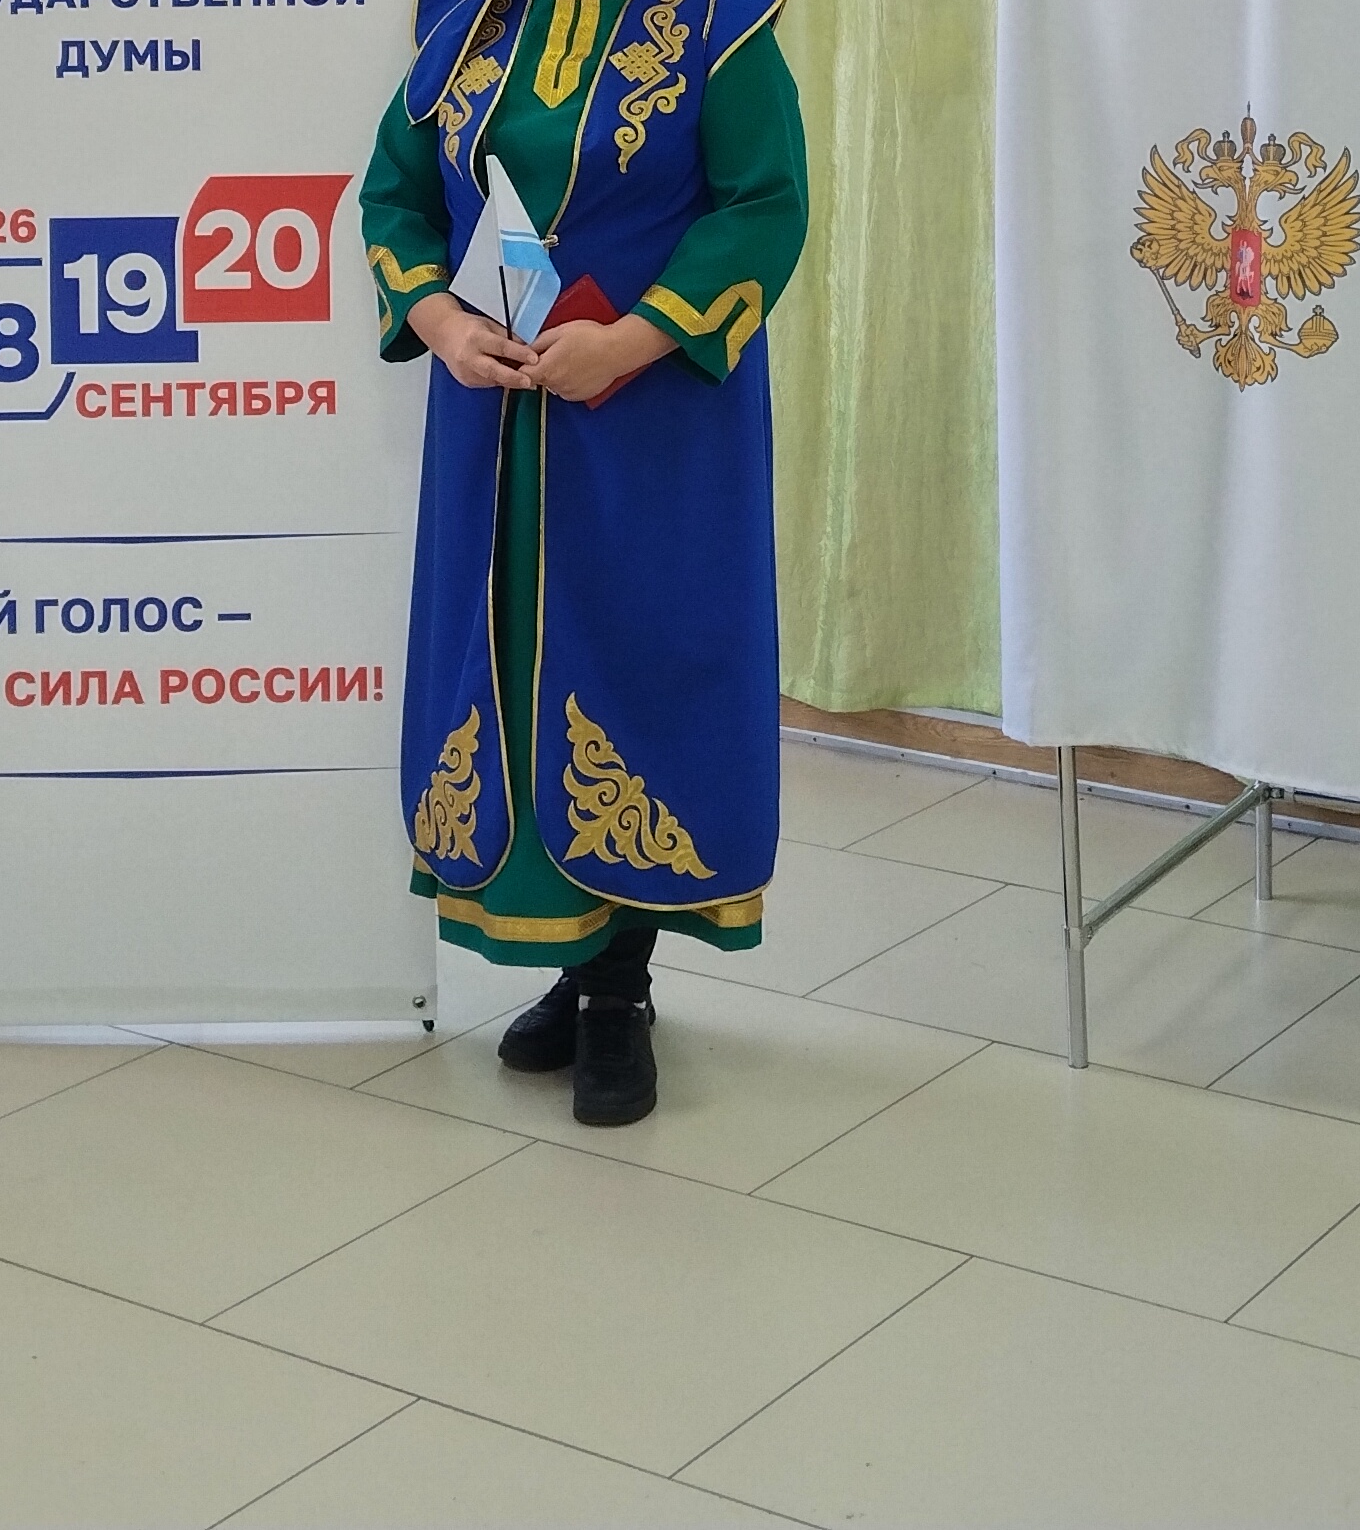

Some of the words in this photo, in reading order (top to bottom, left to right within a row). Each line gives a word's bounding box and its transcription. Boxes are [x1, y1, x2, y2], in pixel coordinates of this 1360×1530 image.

[55, 38, 202, 79] ДУМЫ
[63, 252, 168, 334] 19
[194, 208, 321, 290] 20
[74, 379, 338, 419] СЕНТЯБРЯ
[35, 596, 204, 634] ГОЛОС
[4, 669, 144, 707] СИЛА
[159, 666, 384, 704] РОССИИ!
